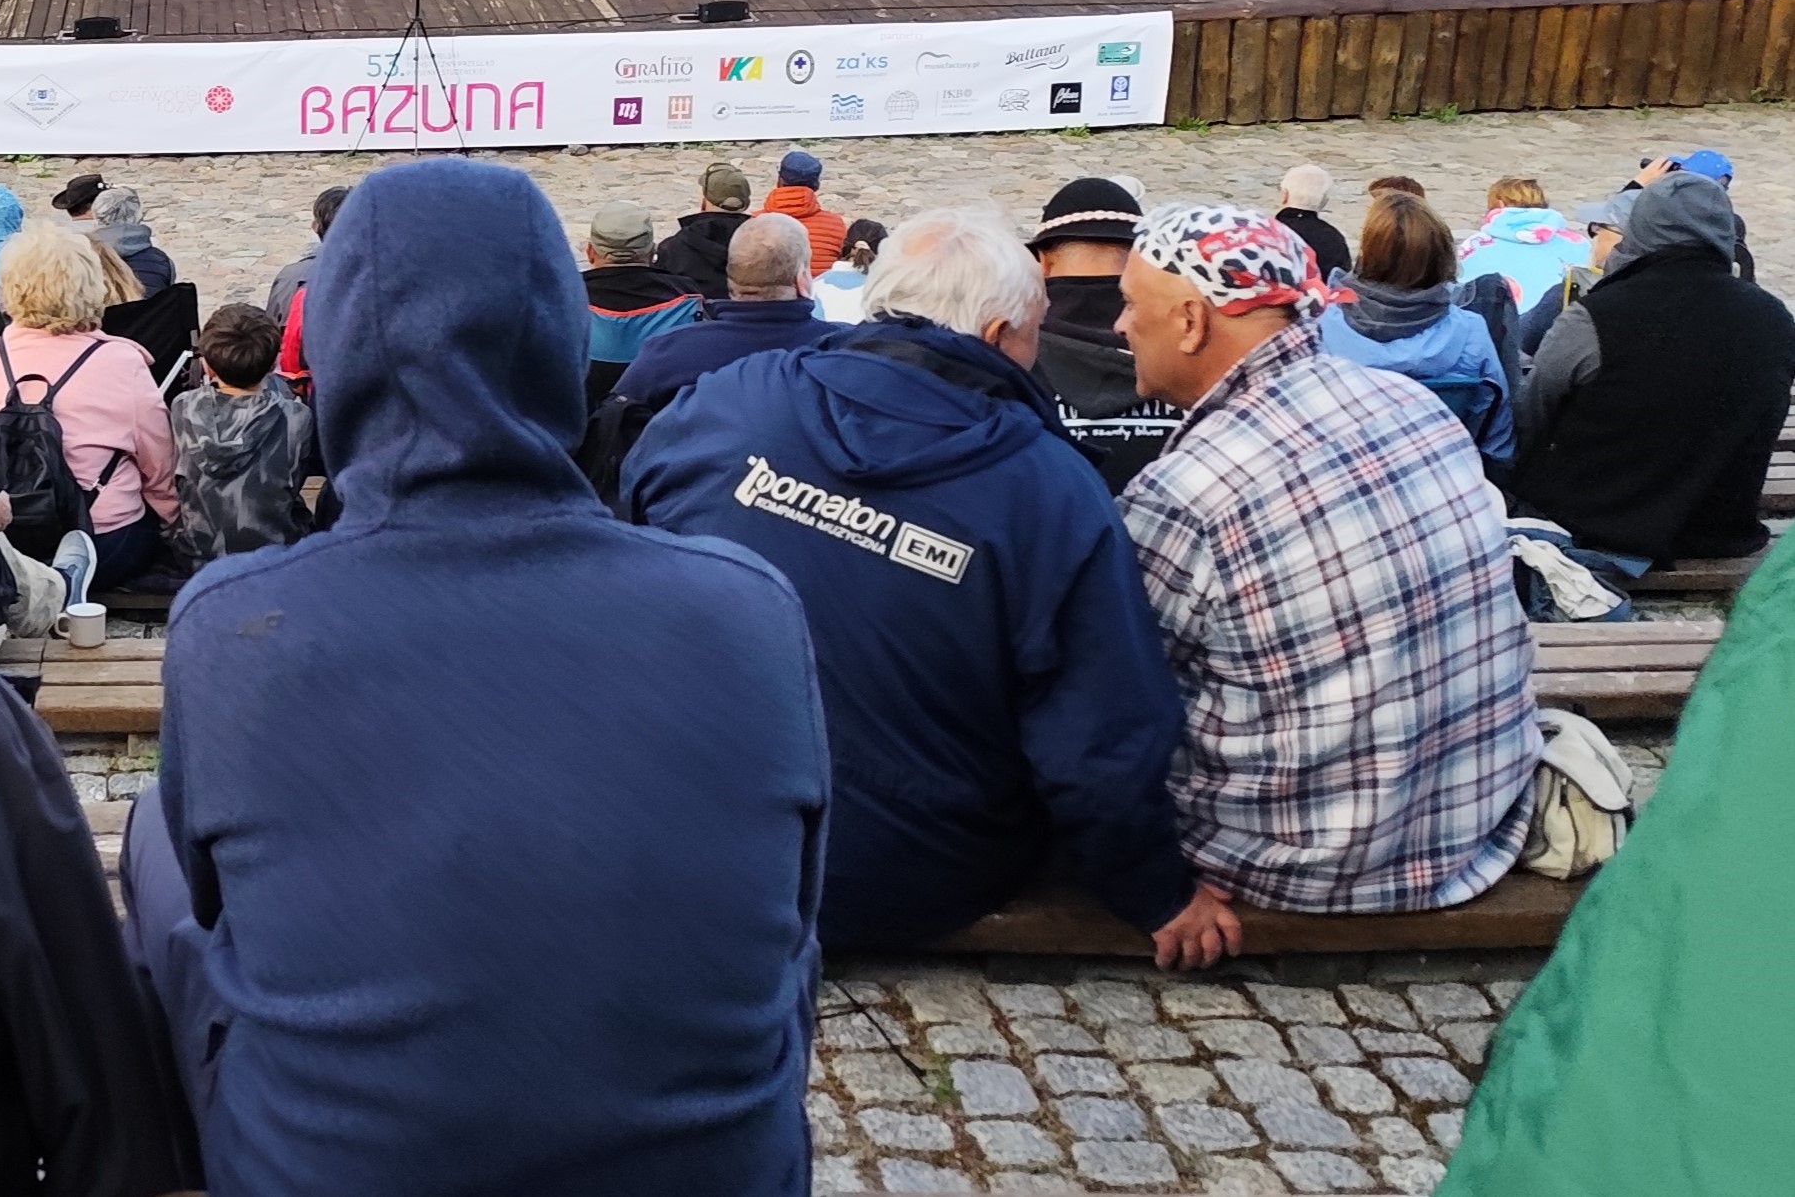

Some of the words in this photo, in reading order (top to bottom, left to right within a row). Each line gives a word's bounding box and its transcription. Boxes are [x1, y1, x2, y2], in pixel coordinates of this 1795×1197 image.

[719, 55, 763, 81] VKA
[1005, 44, 1065, 65] Baltazar
[109, 88, 203, 106] czerwonej
[299, 81, 546, 135] BAZUNA
[1134, 425, 1165, 437] blues
[734, 455, 896, 540] pomaton
[816, 517, 888, 556] MUZYCZNA
[906, 537, 959, 570] EMI
